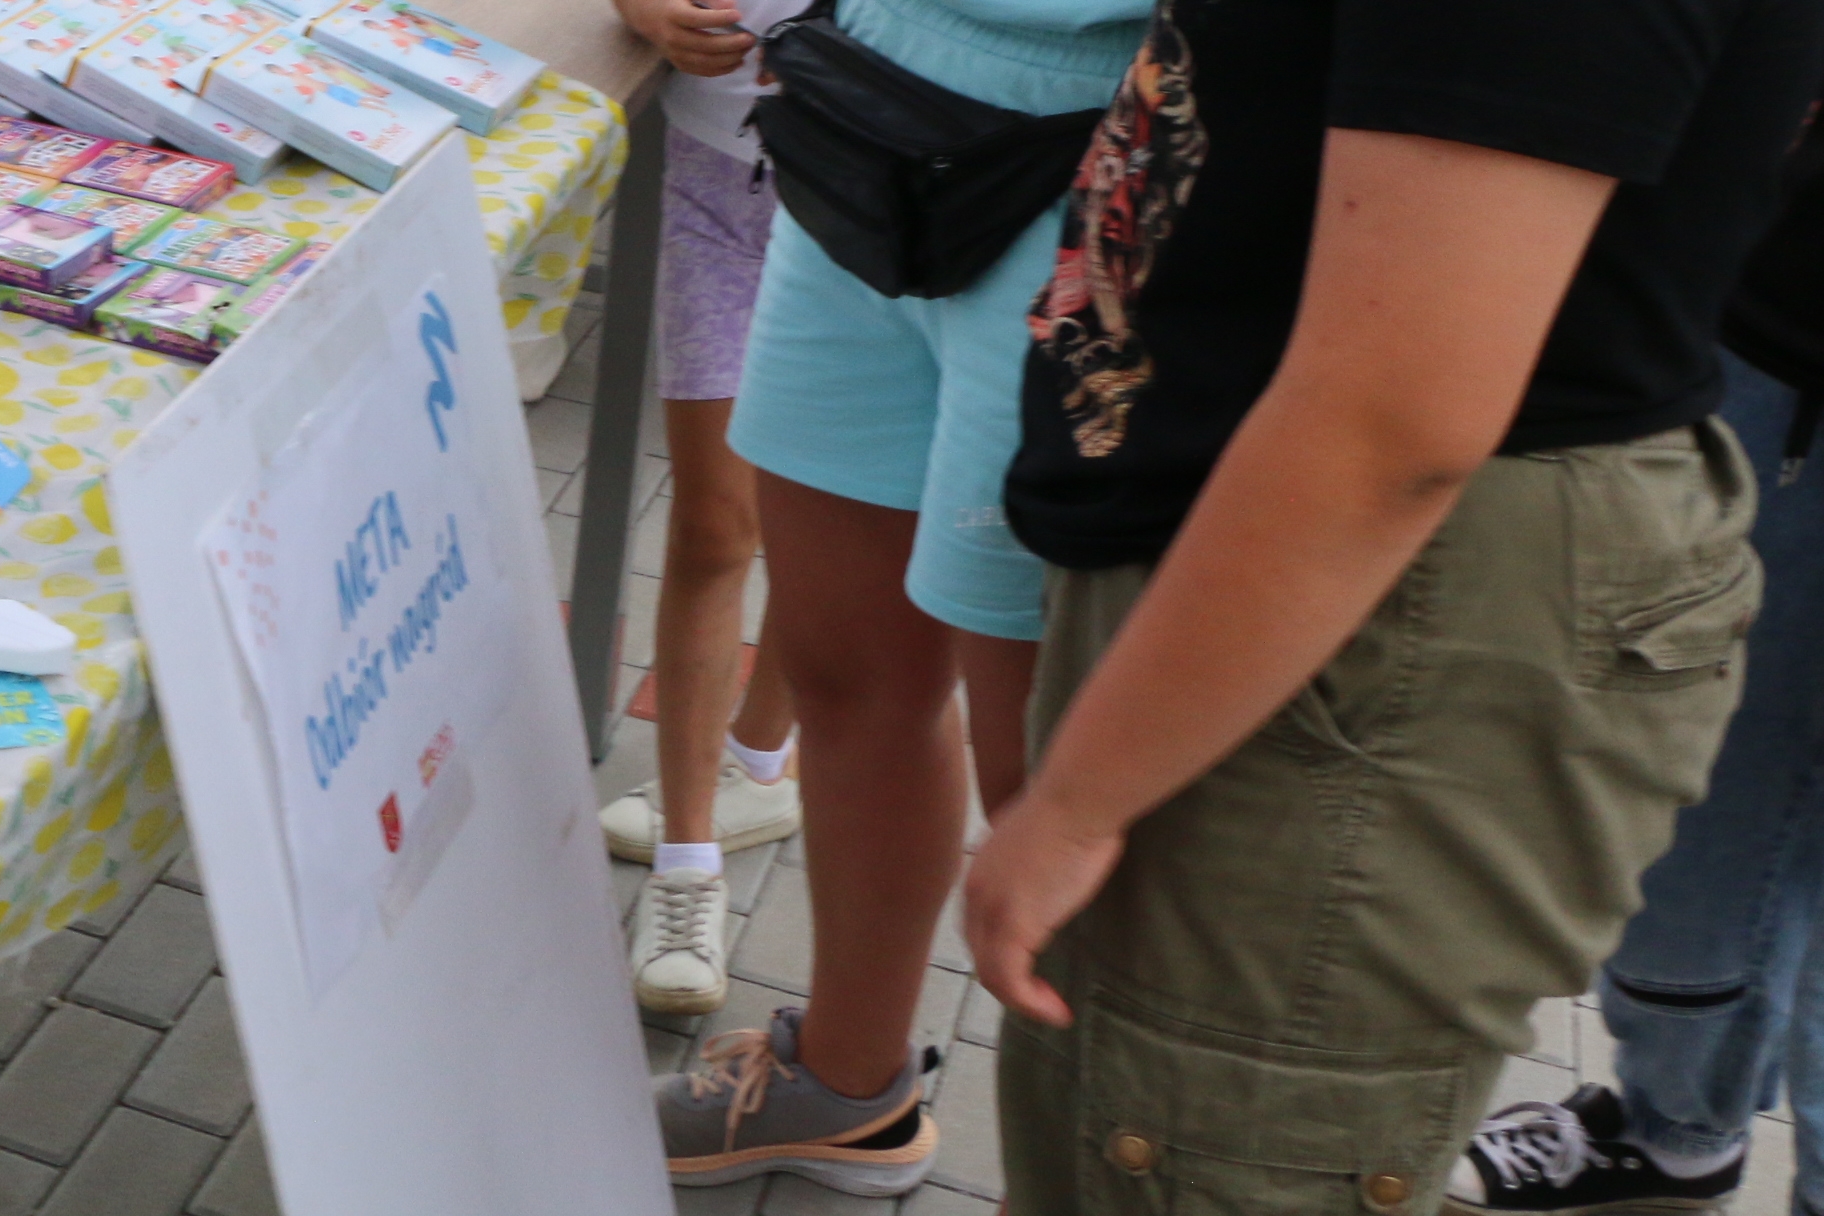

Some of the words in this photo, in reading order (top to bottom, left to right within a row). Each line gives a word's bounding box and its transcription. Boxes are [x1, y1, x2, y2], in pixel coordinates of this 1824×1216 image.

[305, 638, 389, 791] Odbiór
[388, 513, 470, 672] nagród
[334, 490, 411, 632] META
